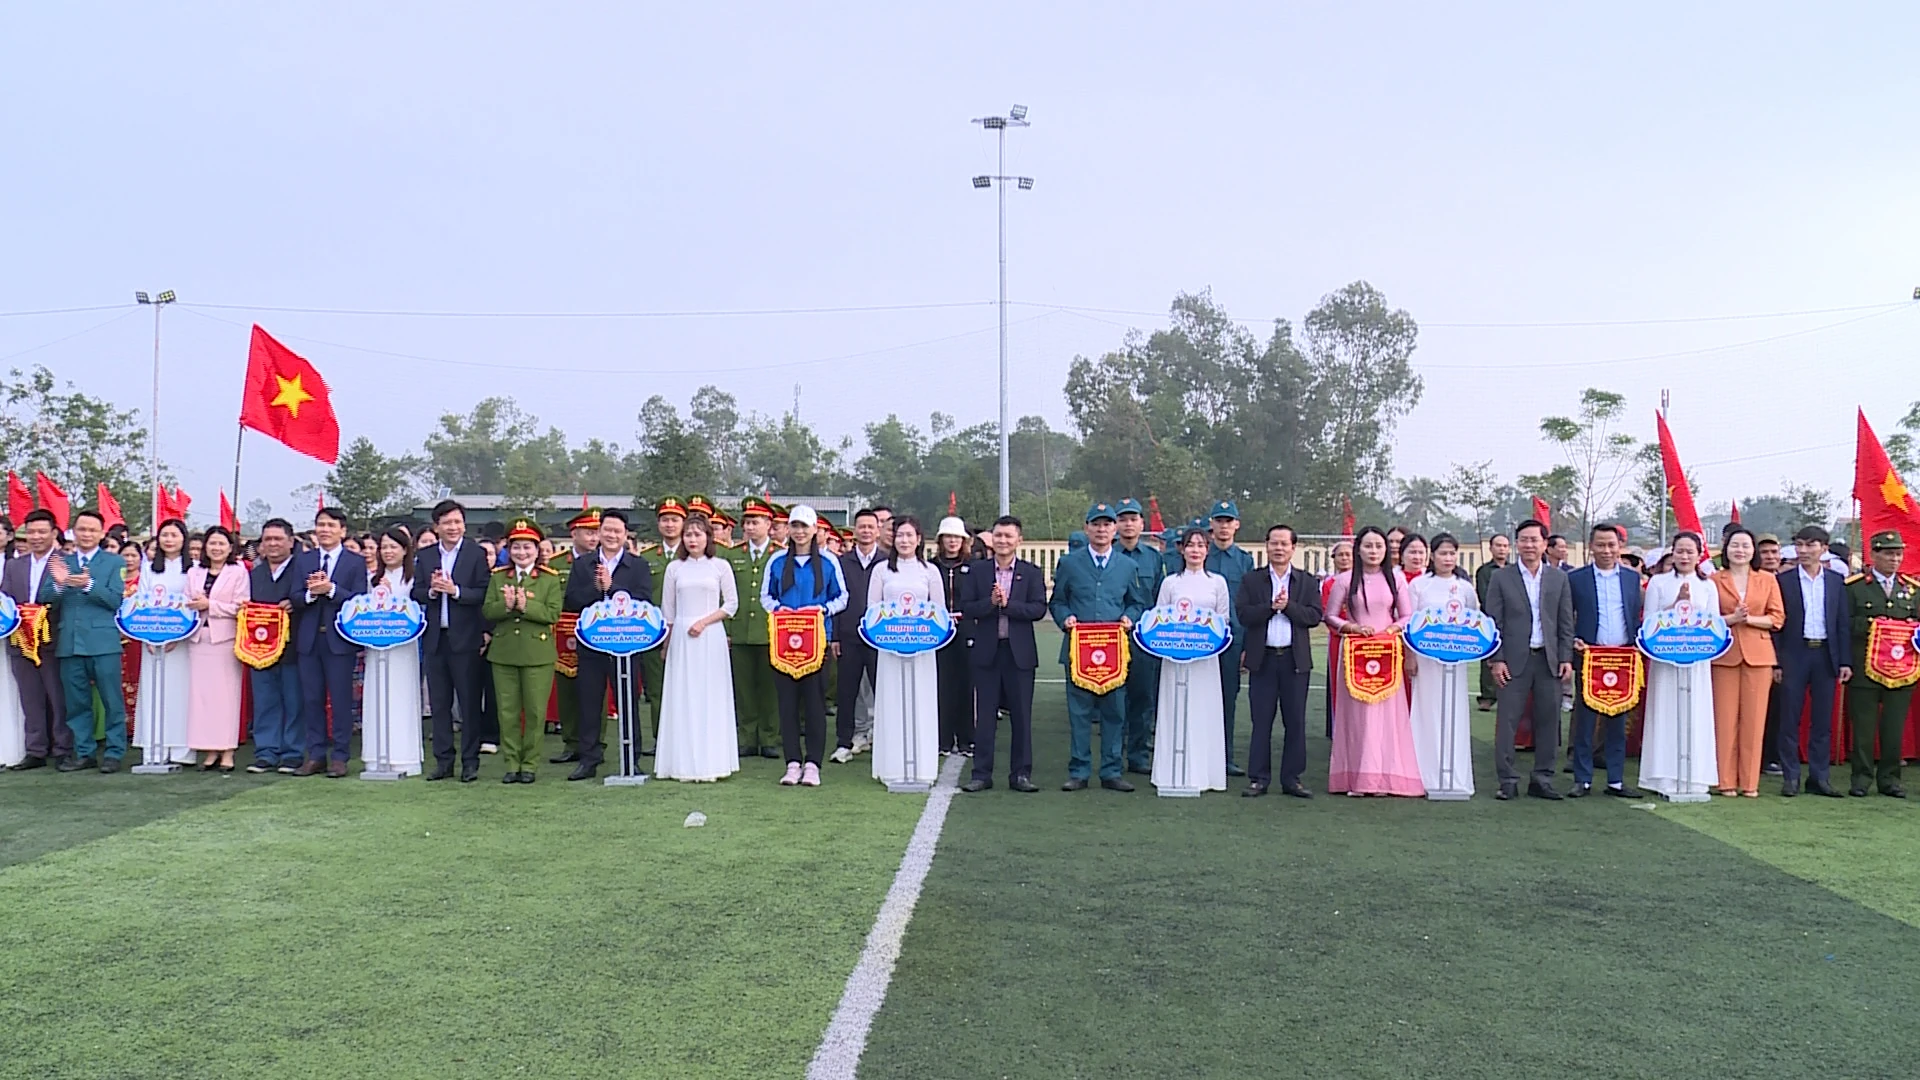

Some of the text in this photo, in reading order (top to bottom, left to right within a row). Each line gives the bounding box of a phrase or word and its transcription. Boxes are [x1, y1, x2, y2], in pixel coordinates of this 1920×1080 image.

[352, 629, 371, 637] NAM
[591, 635, 611, 643] NAM
[876, 635, 897, 643] NAM
[1151, 640, 1172, 648] NAM
[1418, 641, 1440, 649] NAM
[1653, 645, 1674, 653] NAM
